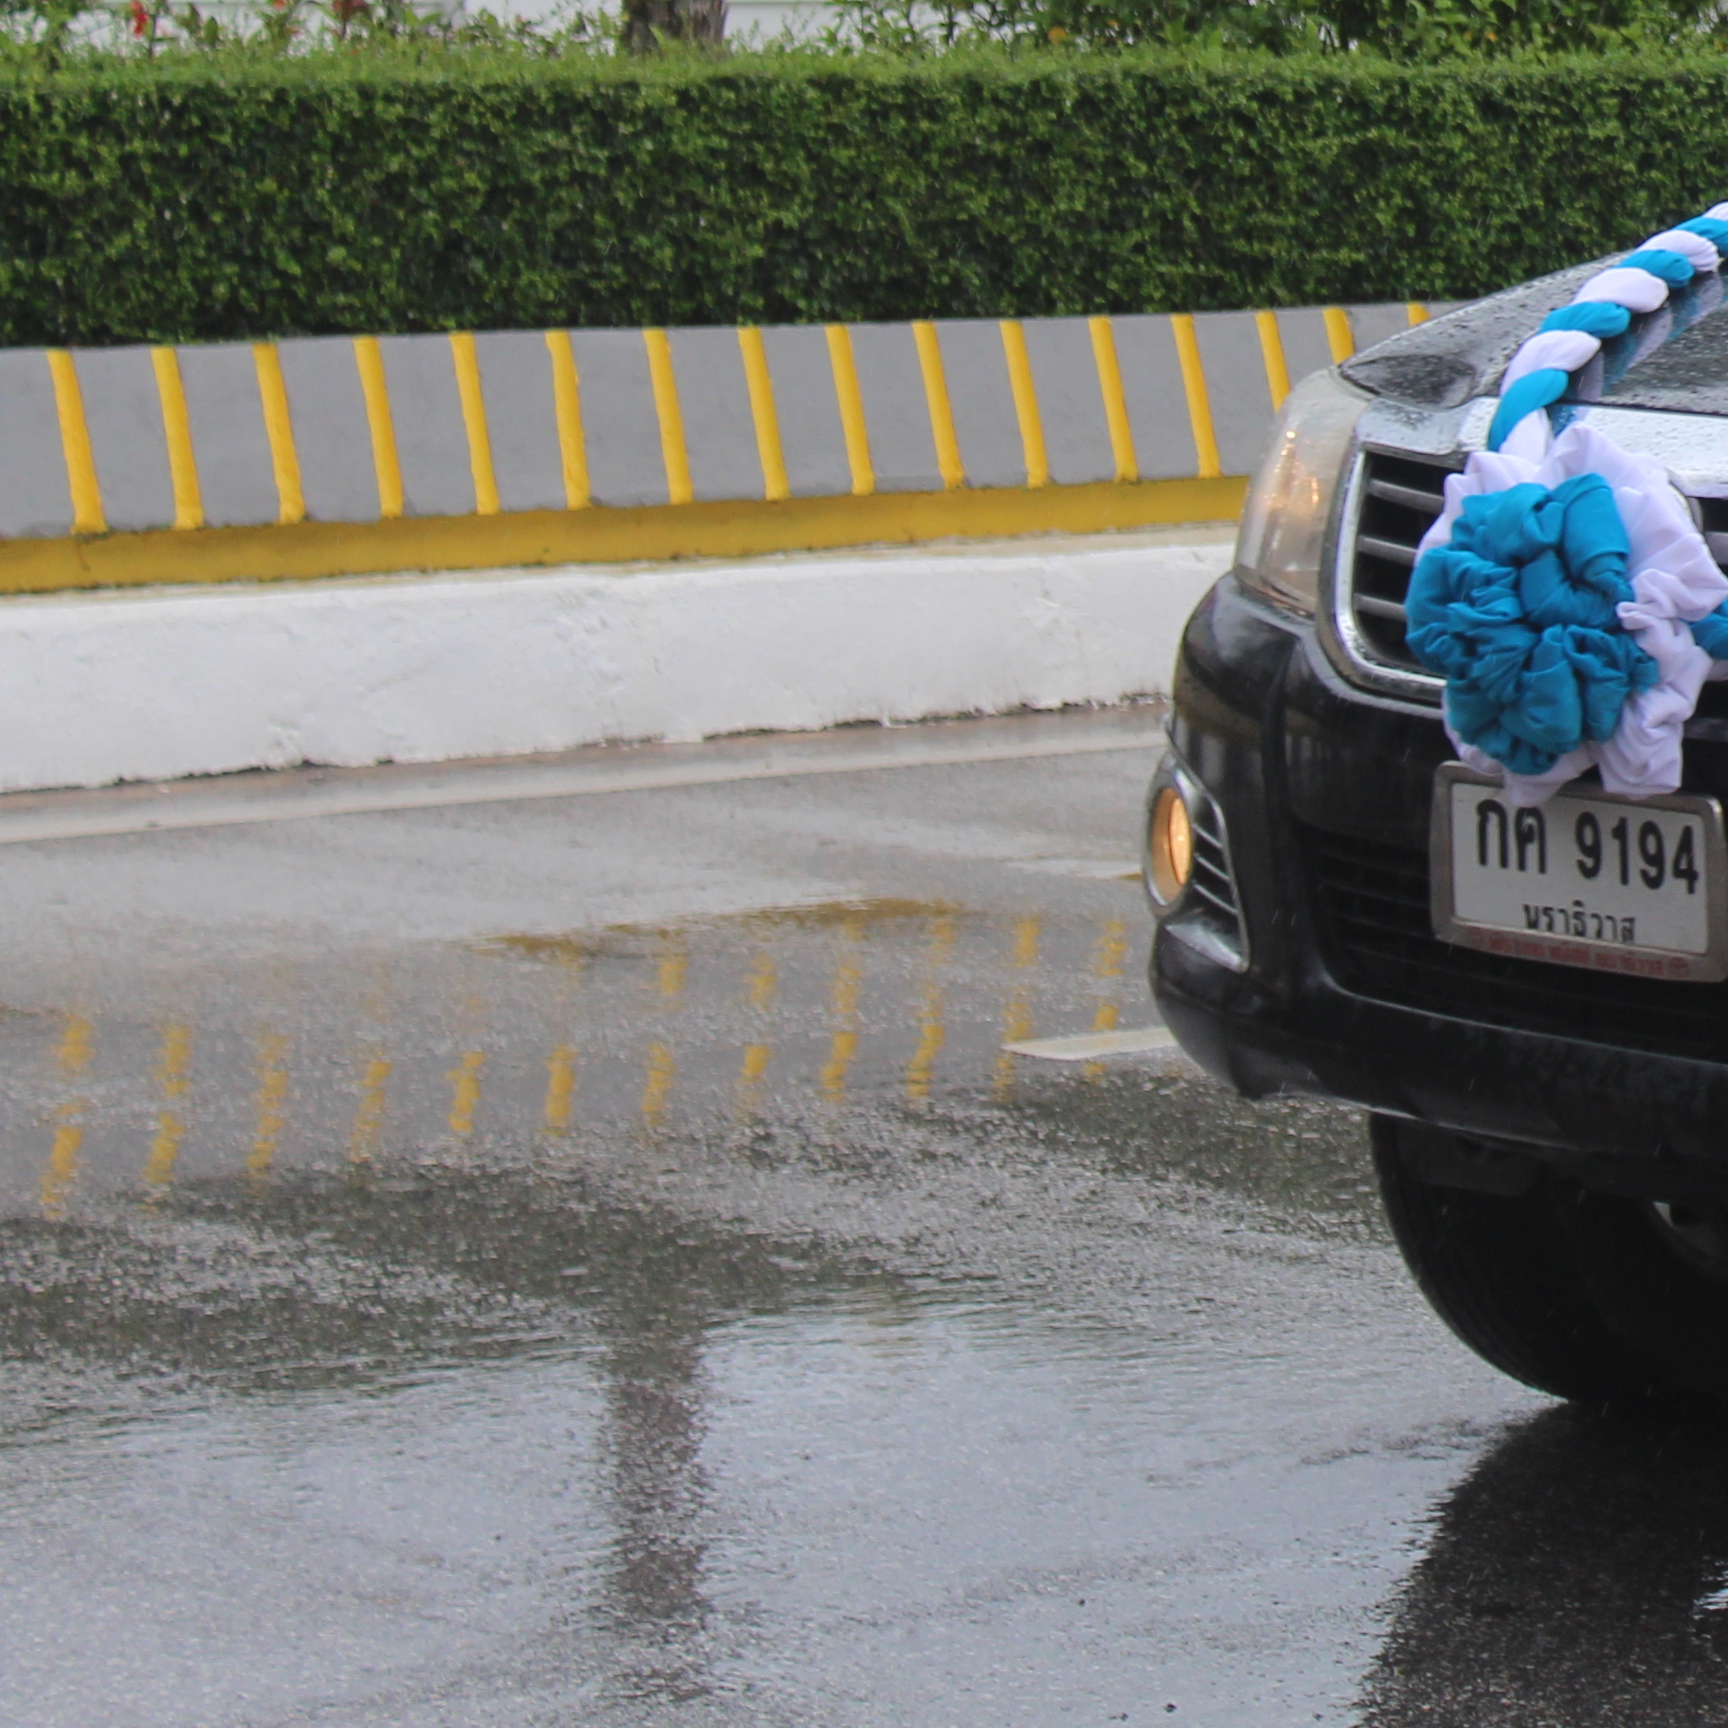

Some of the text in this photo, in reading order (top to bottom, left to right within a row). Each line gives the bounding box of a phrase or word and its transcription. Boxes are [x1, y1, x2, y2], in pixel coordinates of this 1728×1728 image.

[1574, 811, 1699, 894] 9194
[1523, 899, 1636, 944] นราธิวาส
